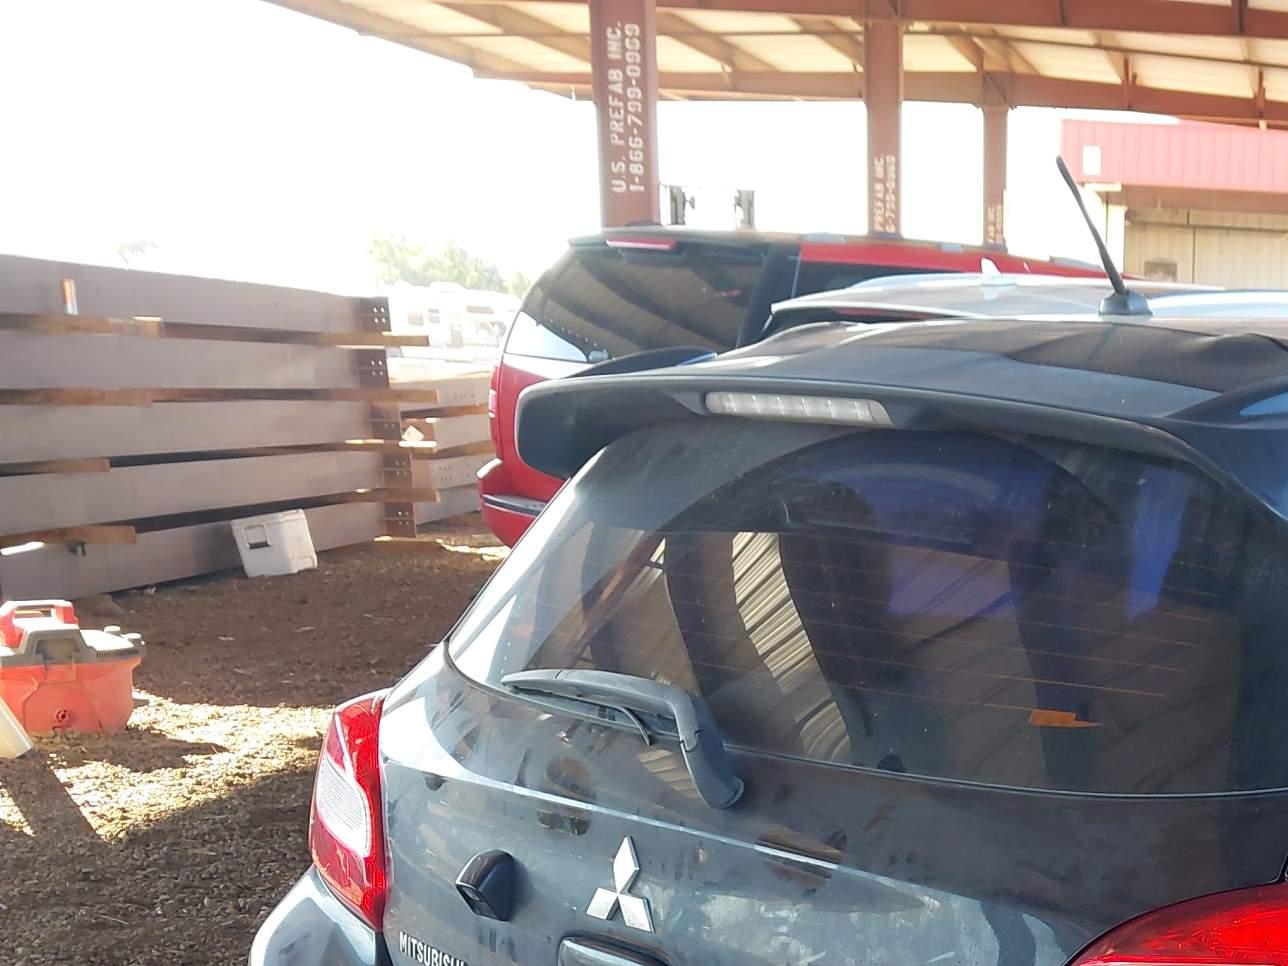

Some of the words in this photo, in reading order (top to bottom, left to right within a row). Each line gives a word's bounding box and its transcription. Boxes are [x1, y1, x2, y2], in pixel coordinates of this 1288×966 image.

[606, 21, 622, 60] INC.
[607, 68, 625, 146] PREFAB
[624, 23, 645, 193] 1-866-799-0969
[611, 155, 627, 193] U.S.
